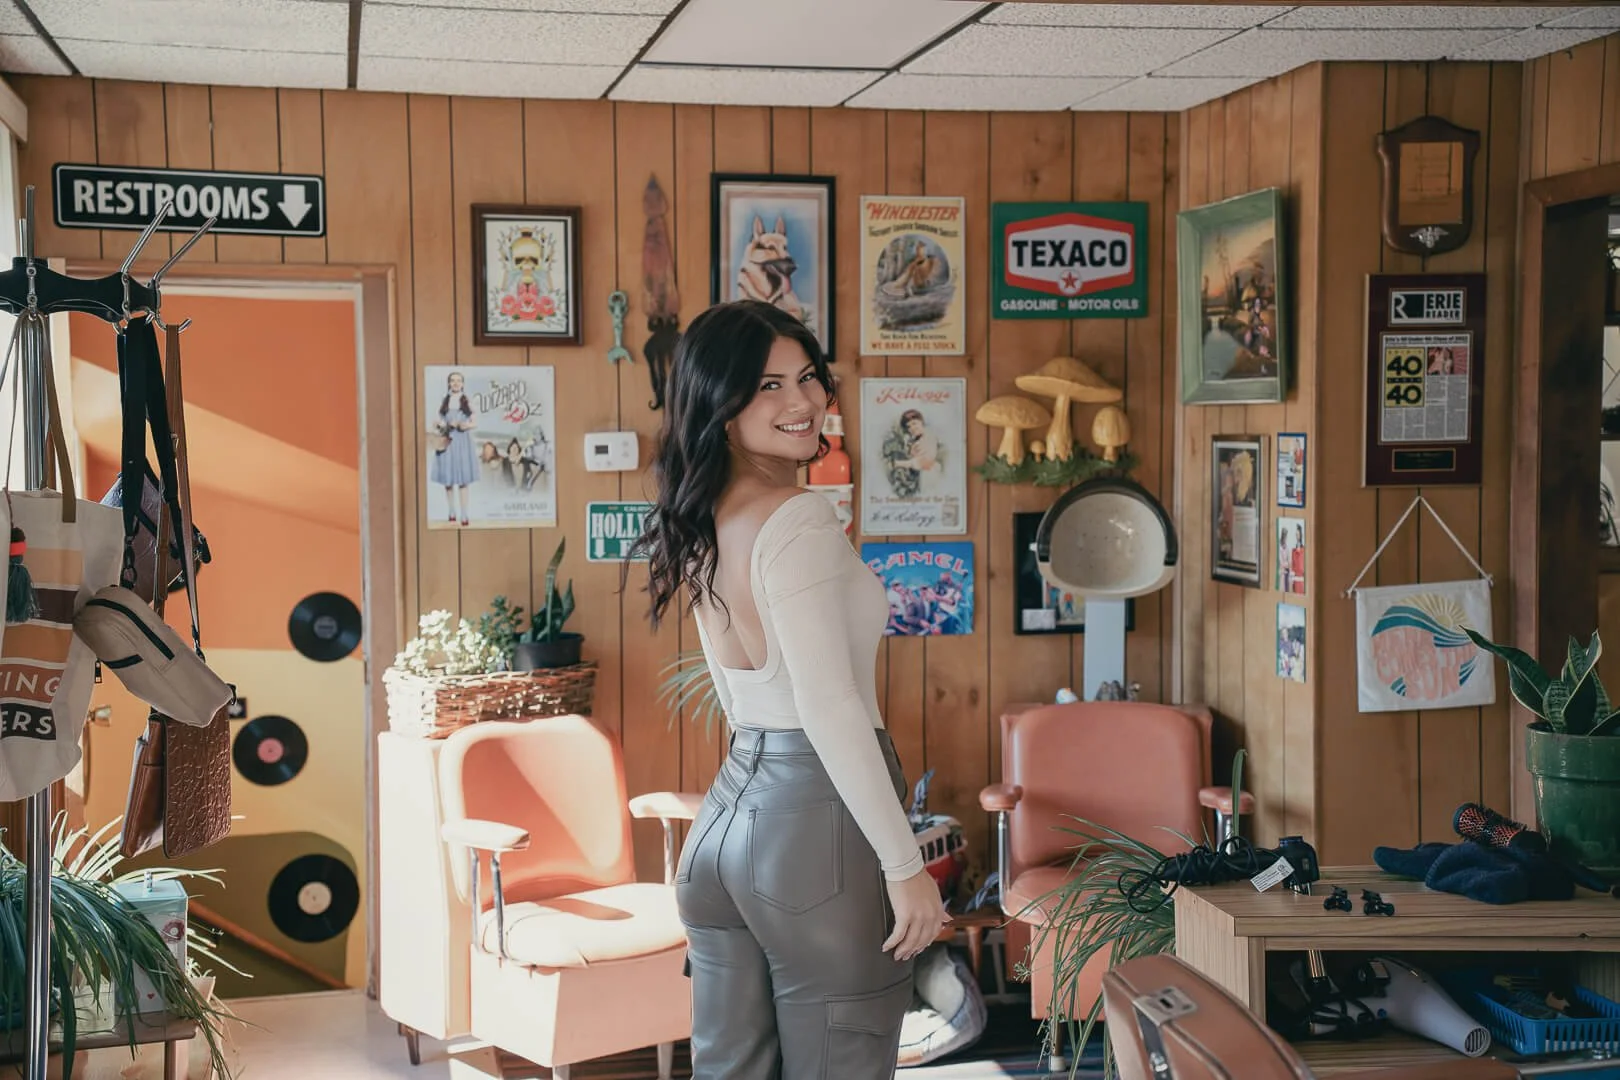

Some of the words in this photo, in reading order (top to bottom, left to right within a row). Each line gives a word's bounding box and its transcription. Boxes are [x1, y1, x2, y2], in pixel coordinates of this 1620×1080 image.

[73, 179, 270, 221] RESTROOMS
[867, 202, 960, 221] WINCHESTER
[1012, 239, 1127, 268] TEXACO
[1000, 299, 1058, 311] GASOLINE
[1068, 299, 1111, 311] MOTOR
[1112, 299, 1139, 310] OILS
[1427, 293, 1461, 309] ERIE
[1427, 310, 1460, 319] READER
[1387, 355, 1422, 376] 40
[1387, 385, 1422, 405] 40
[591, 513, 648, 539] HOLLY
[867, 551, 967, 576] CAMEL
[0, 671, 61, 697] ING
